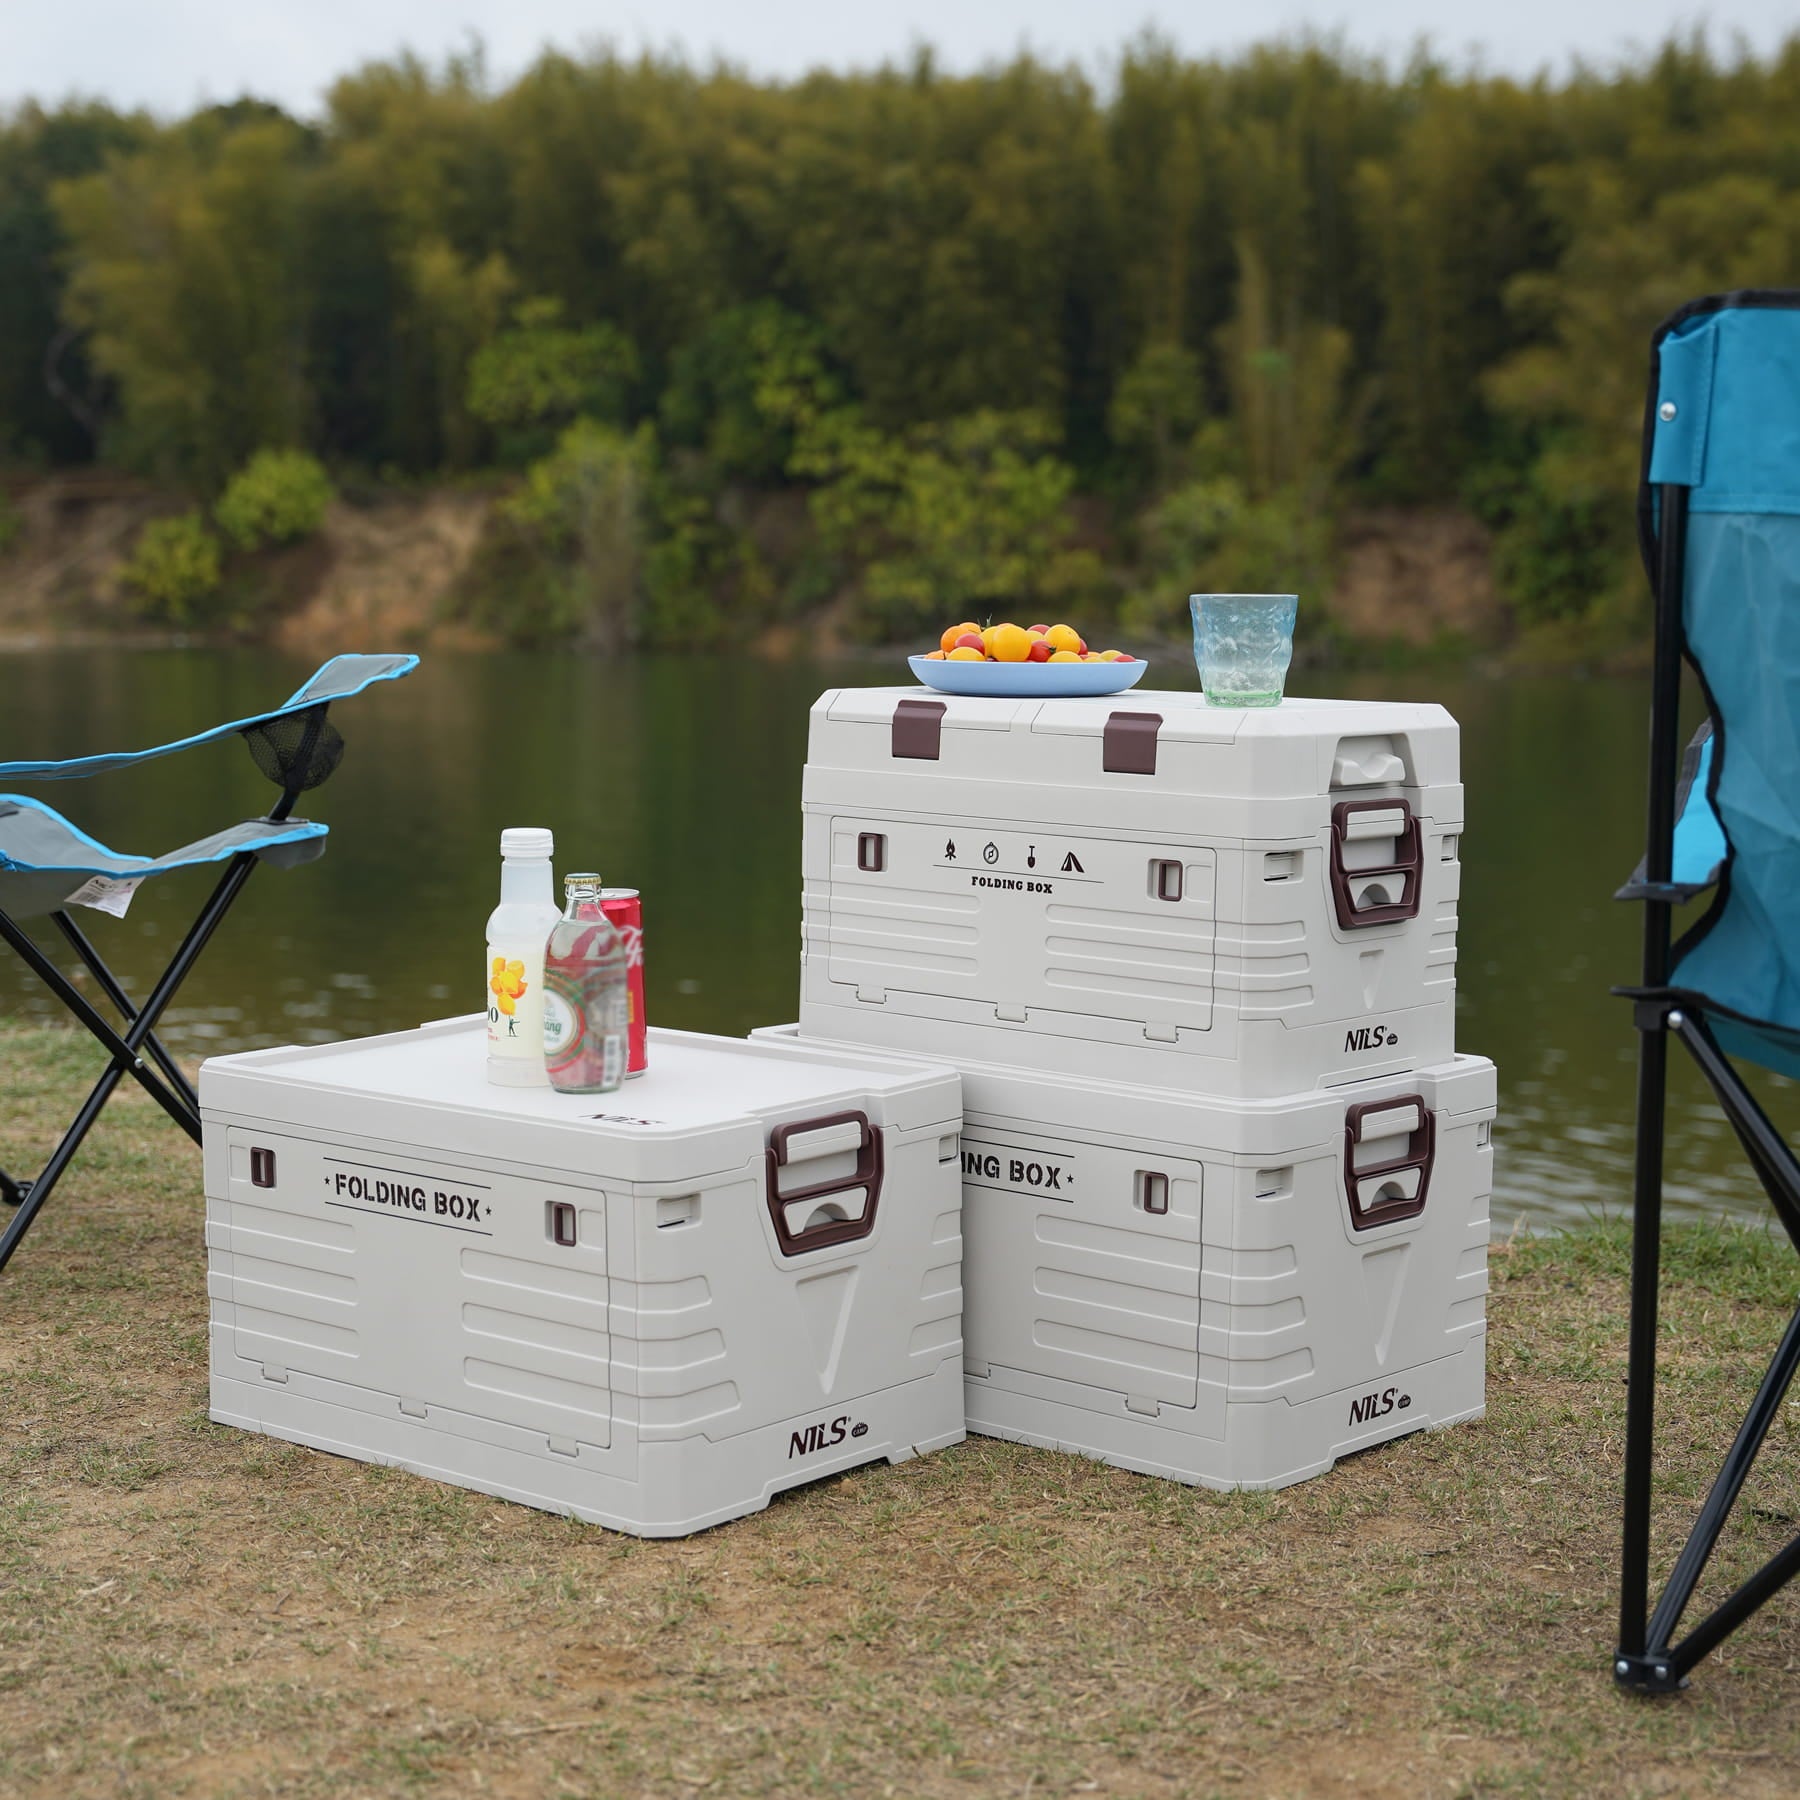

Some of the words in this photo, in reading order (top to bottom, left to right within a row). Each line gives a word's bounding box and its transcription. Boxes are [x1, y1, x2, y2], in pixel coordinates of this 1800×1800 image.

[971, 876, 1024, 892] FOLDING
[1026, 881, 1053, 895] BOX
[1344, 1025, 1385, 1053] NILS
[961, 1151, 1001, 1179] ING
[1009, 1159, 1062, 1190] BOX
[335, 1173, 427, 1212] FOLDING
[434, 1191, 481, 1222] BOX
[1348, 1387, 1396, 1427] NILS
[788, 1416, 848, 1459] NILS
